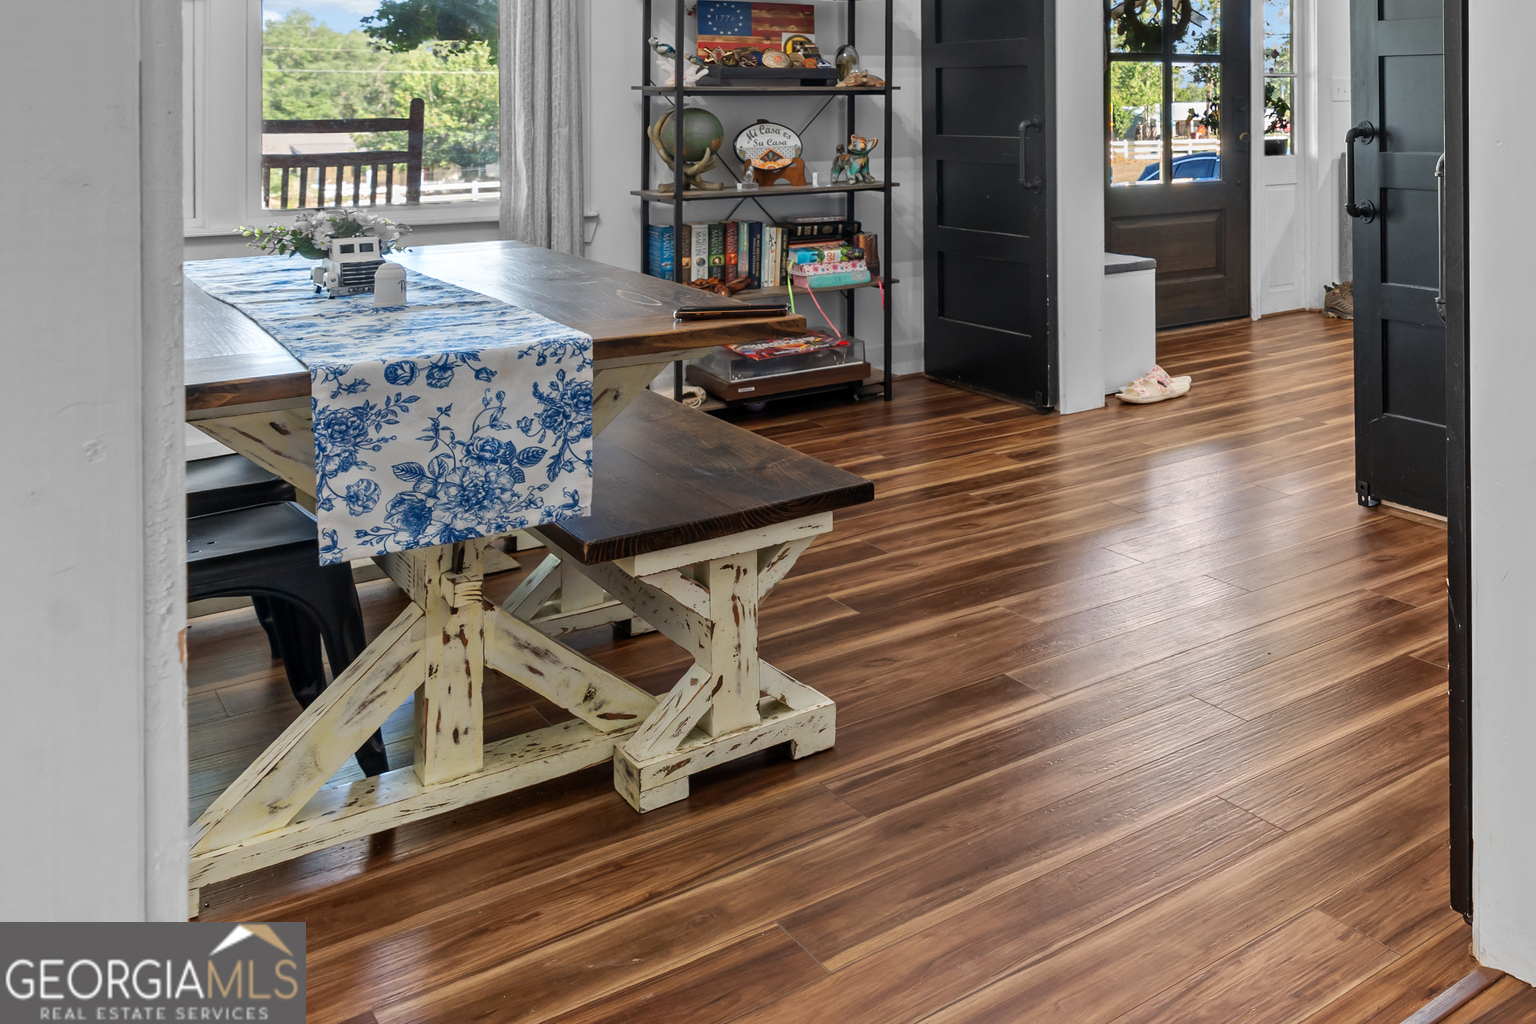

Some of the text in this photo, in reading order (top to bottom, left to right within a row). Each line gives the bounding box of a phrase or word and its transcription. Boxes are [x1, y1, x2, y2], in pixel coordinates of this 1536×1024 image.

[746, 125, 792, 144] Mi Casa es
[753, 138, 788, 147] Su Casa
[663, 233, 671, 258] MARTIN
